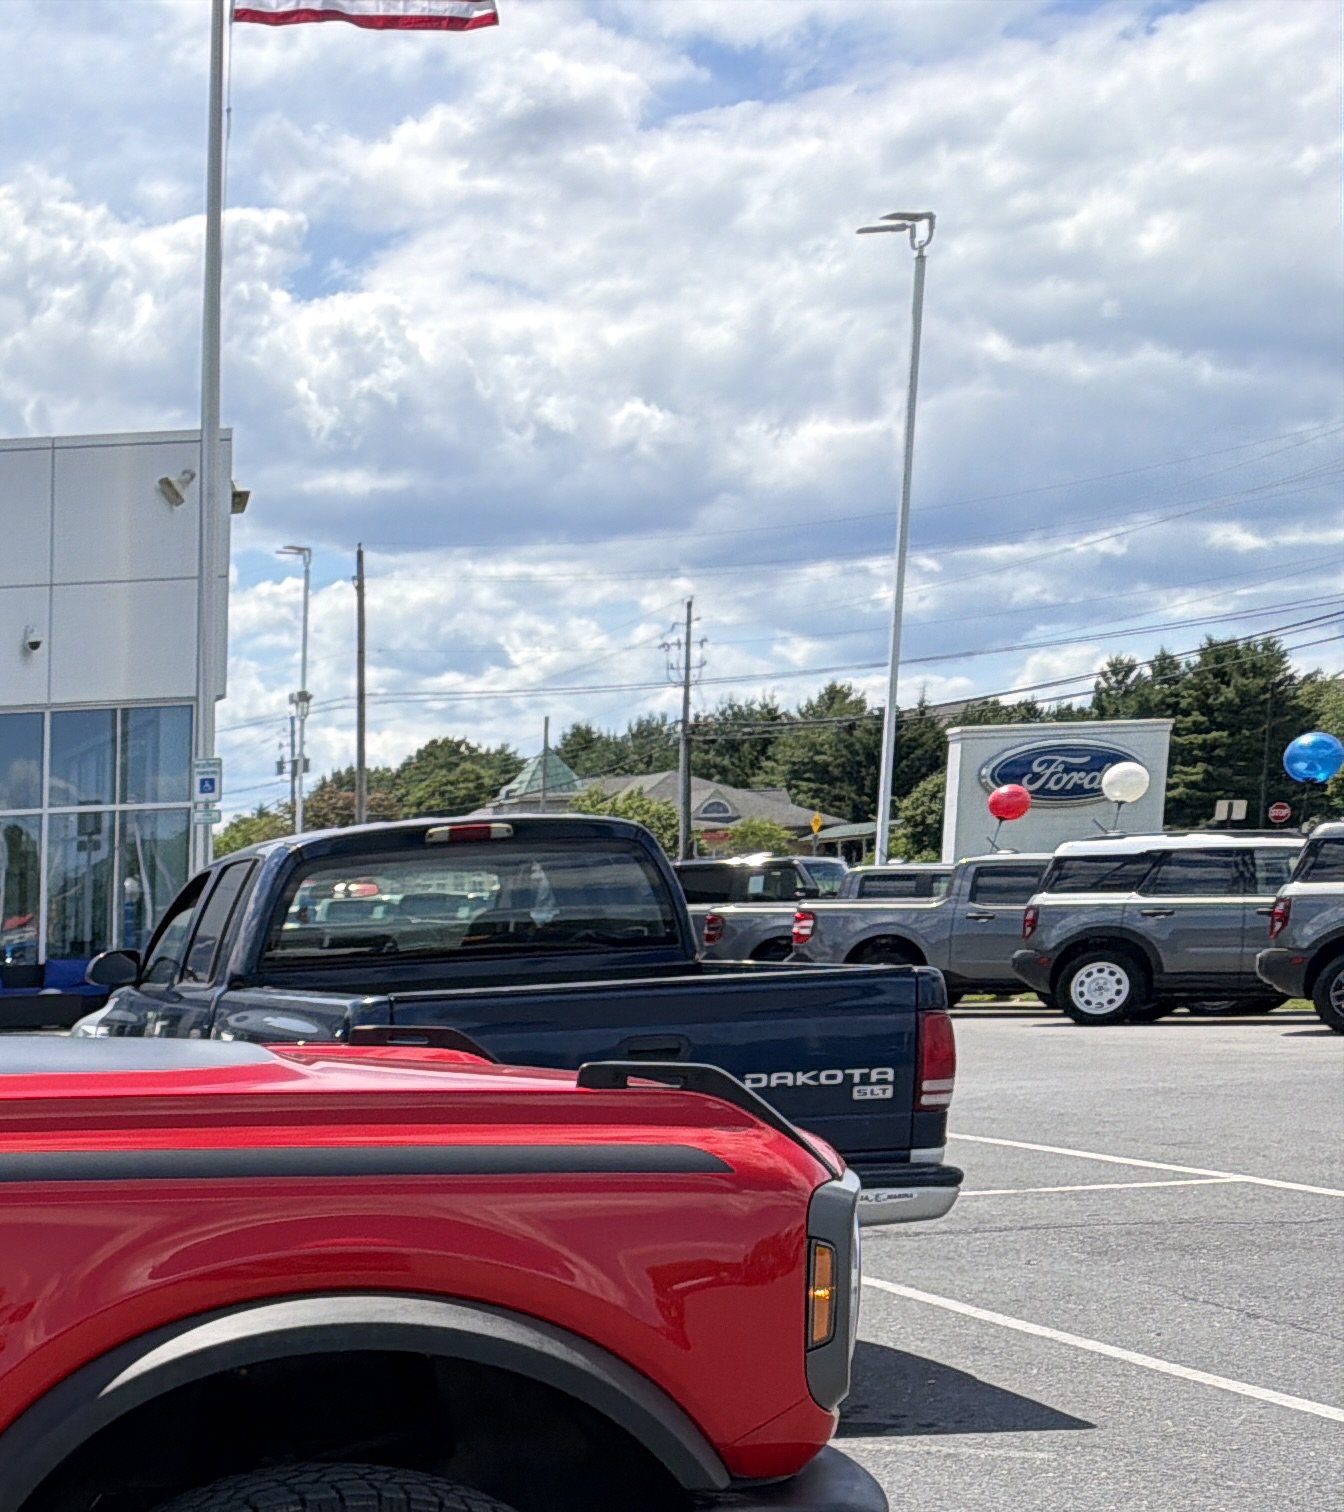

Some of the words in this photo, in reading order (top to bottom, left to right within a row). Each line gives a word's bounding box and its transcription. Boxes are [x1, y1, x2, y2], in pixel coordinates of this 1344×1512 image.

[1021, 755, 1112, 791] Ford
[744, 1067, 895, 1088] DAKOTA
[856, 1087, 890, 1097] SLT
